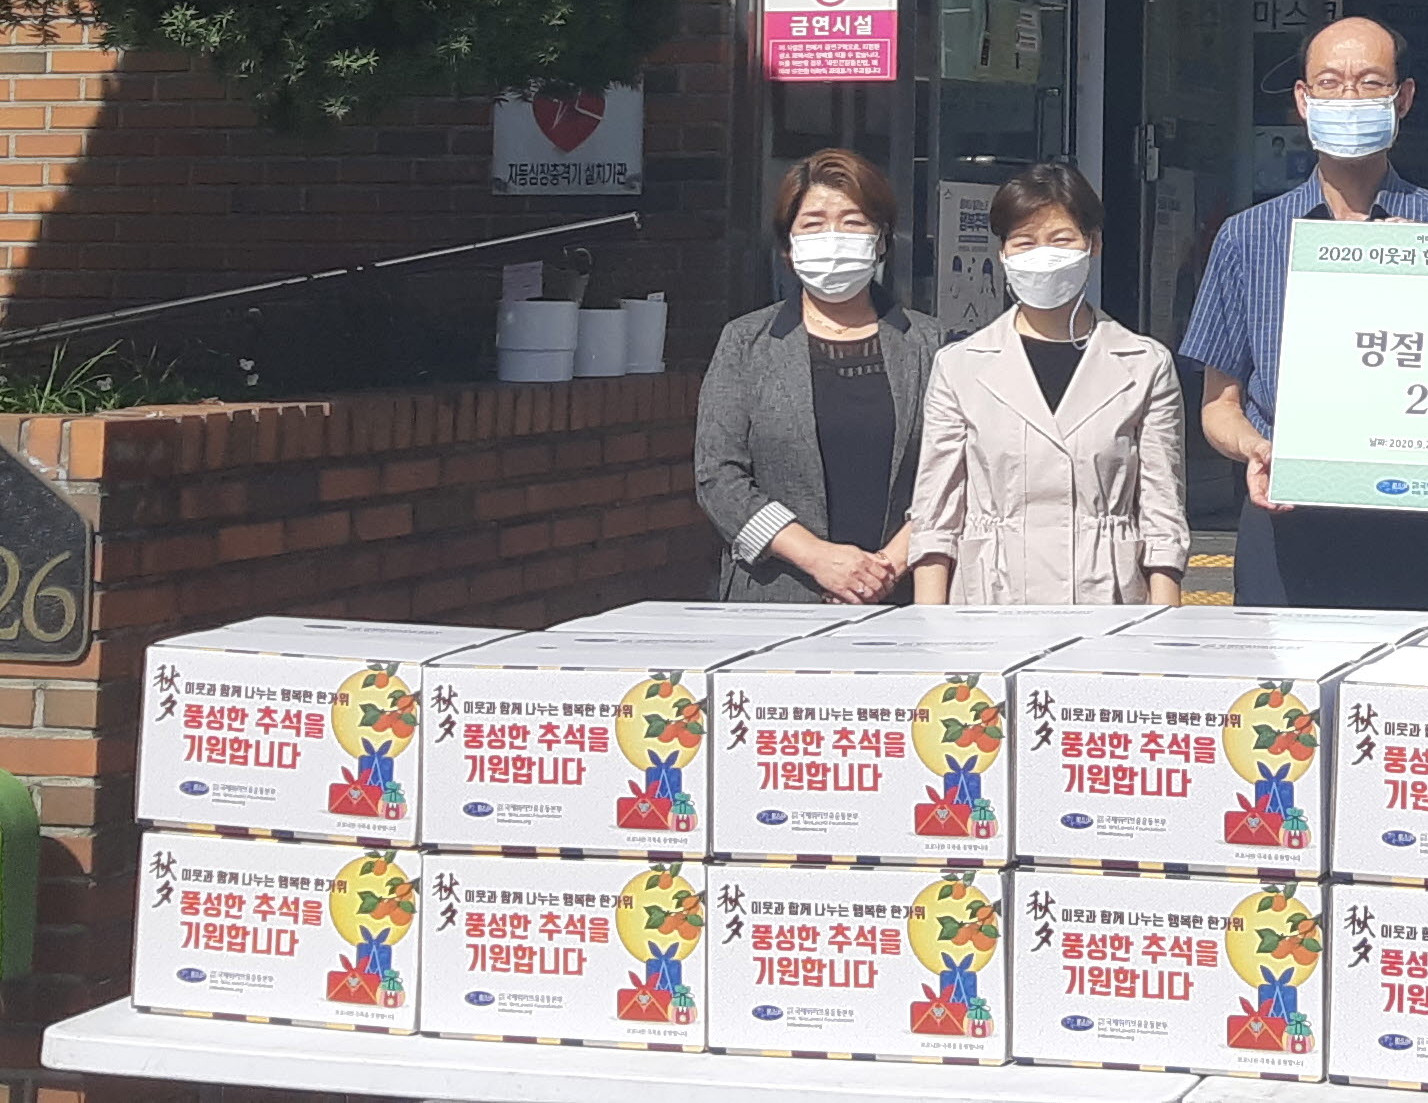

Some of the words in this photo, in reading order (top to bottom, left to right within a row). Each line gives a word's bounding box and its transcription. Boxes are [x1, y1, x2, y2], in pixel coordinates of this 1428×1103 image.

[790, 15, 872, 36] 금연시설
[586, 163, 627, 185] 설치기관
[1319, 247, 1363, 262] 2020
[1370, 248, 1416, 265] 이웃과
[1355, 330, 1424, 368] 명절
[153, 664, 181, 721] 秋夕
[183, 705, 248, 732] 풍성한
[255, 706, 325, 739] 추석을
[431, 684, 459, 742] 秋夕
[722, 690, 750, 749] 秋夕
[1026, 690, 1056, 750] 秋夕
[1061, 709, 1096, 722] 이웃과
[1100, 709, 1123, 723] 함께
[1127, 710, 1162, 725] 나누는
[1166, 712, 1201, 726] 행복한
[1205, 713, 1241, 728] 한가위
[463, 724, 530, 750] 풍성한
[538, 722, 609, 752] 추석을
[756, 729, 825, 756] 풍성한
[832, 727, 906, 758] 추석을
[1061, 731, 1132, 760] 풍성한
[1140, 731, 1216, 763] 추석을
[1348, 703, 1379, 765] 秋夕
[183, 735, 301, 769] 기원합니다
[463, 755, 586, 785] 기원합니다
[757, 761, 882, 791] 기원합니다
[1062, 763, 1192, 797] 기원합니다
[149, 851, 177, 908] 秋夕
[180, 891, 246, 919] 풍성한
[253, 894, 323, 925] 추석을
[432, 873, 461, 931] 秋夕
[717, 884, 747, 943] 秋夕
[465, 912, 531, 940] 풍성한
[538, 912, 610, 943] 추석을
[1026, 890, 1057, 951] 秋夕
[1344, 905, 1375, 967] 秋夕
[180, 921, 299, 956] 기원합니다
[751, 924, 820, 951] 풍성한
[828, 923, 901, 955] 추석을
[1062, 932, 1134, 962] 풍성한
[1141, 933, 1219, 967] 추석을
[466, 943, 587, 976] 기원합니다
[752, 956, 878, 988] 기원합니다
[1062, 965, 1194, 1001] 기원합니다
